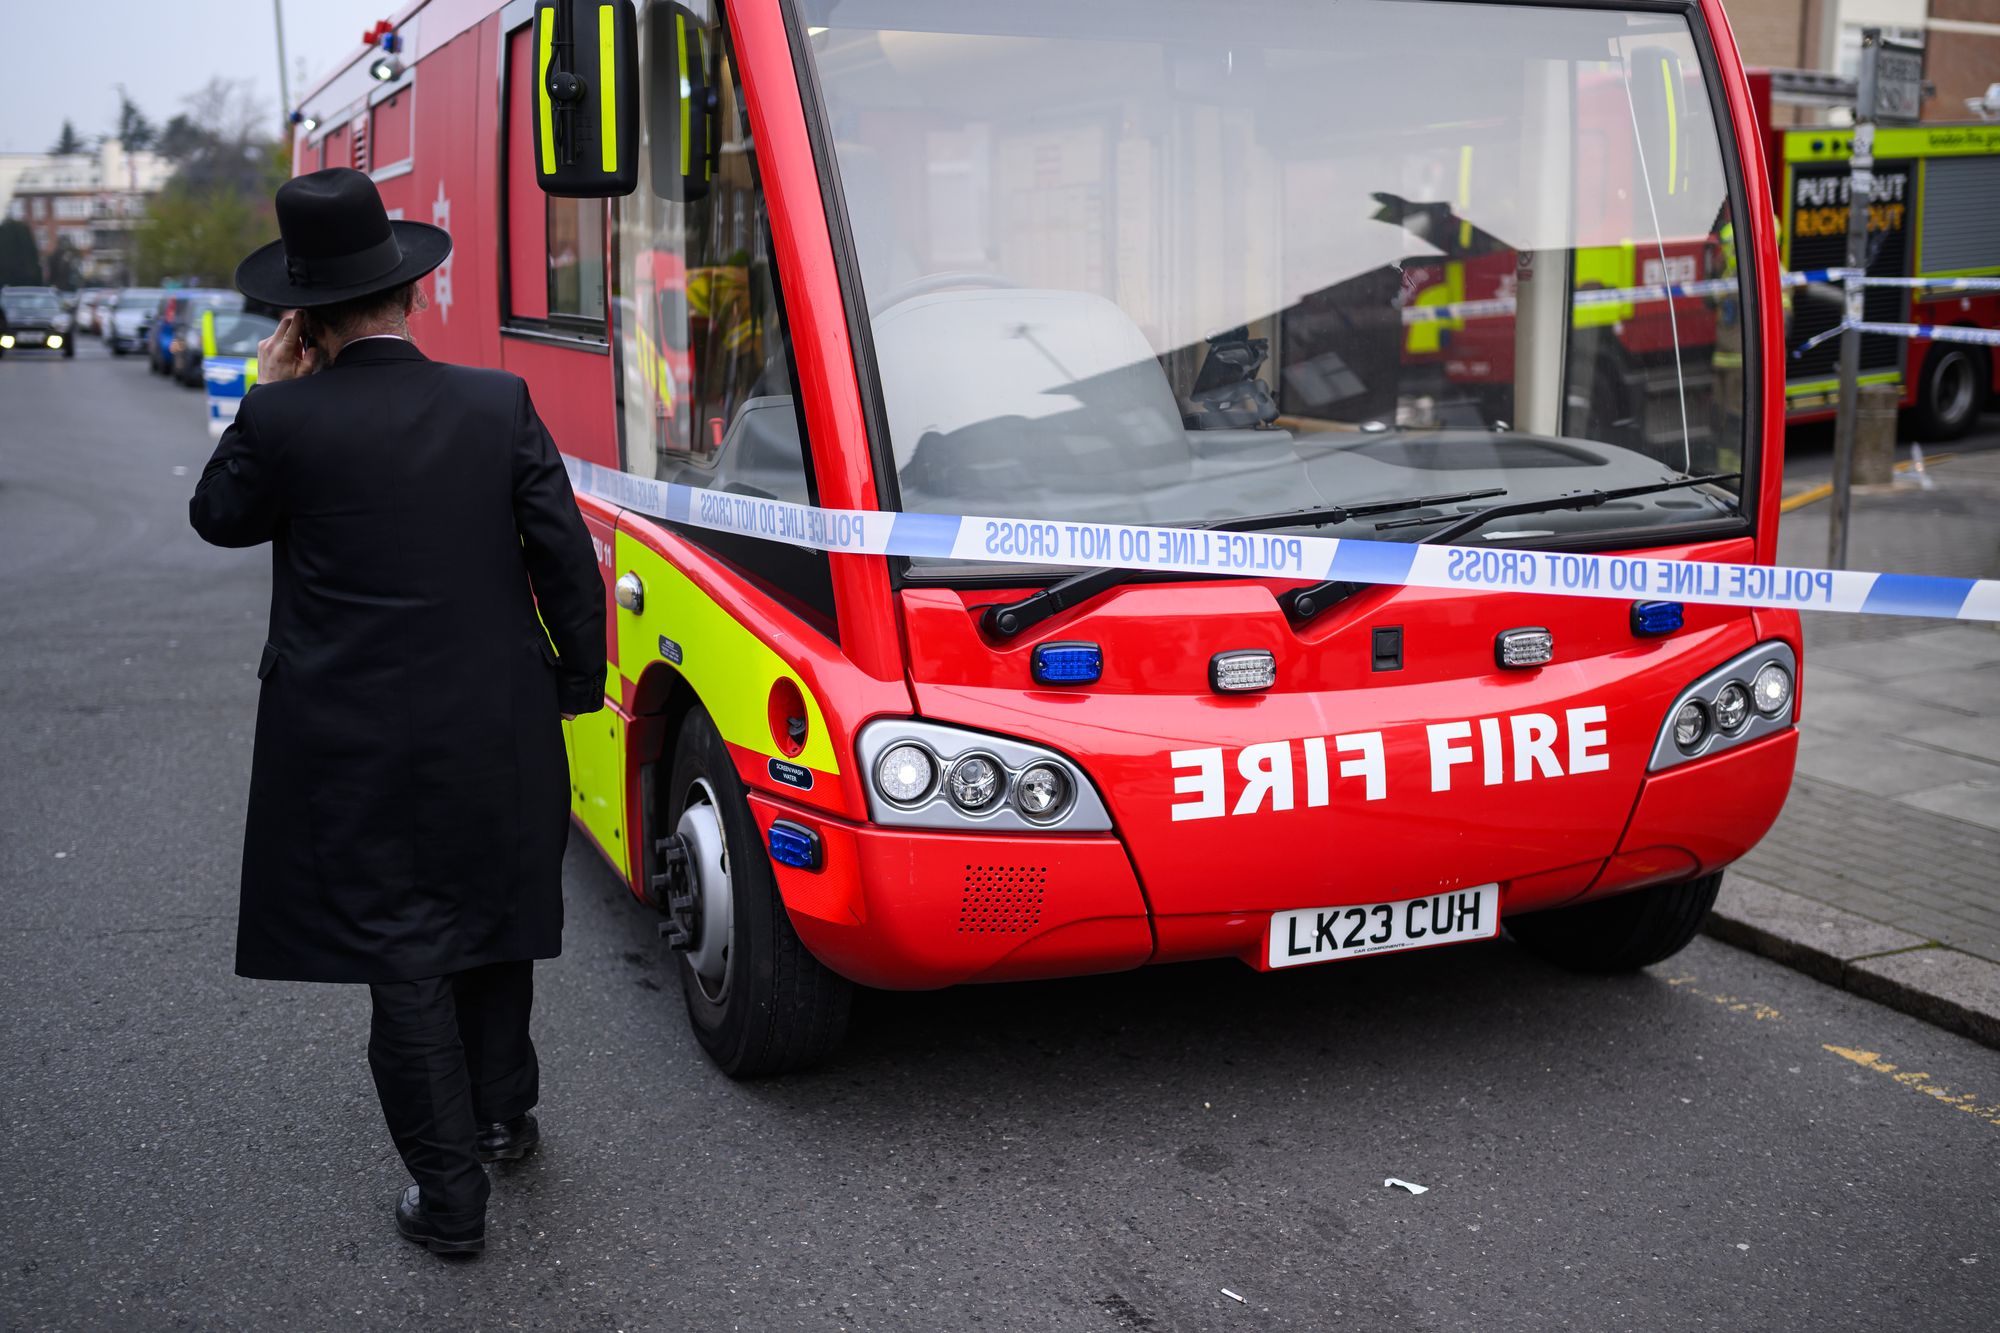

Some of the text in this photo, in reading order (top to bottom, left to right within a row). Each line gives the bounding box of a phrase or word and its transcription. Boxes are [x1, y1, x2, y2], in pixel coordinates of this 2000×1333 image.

[1798, 177, 1838, 206] PUT
[1796, 207, 1849, 237] RIGH
[1426, 705, 1609, 793] FIRE
[1288, 891, 1481, 957] LK23 CUH
